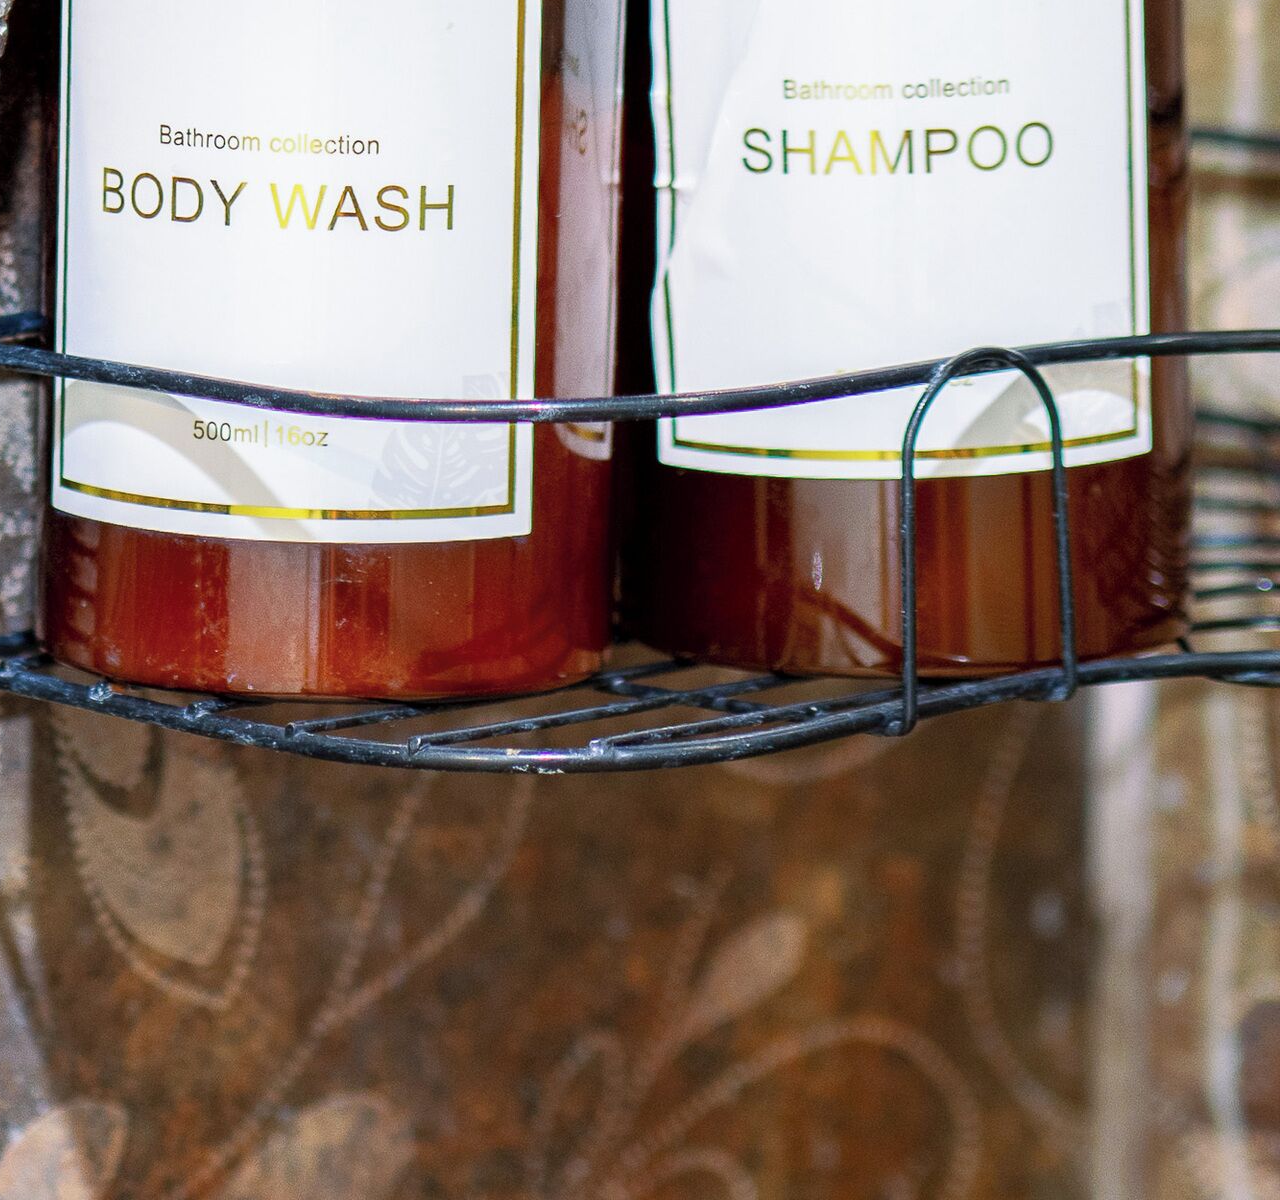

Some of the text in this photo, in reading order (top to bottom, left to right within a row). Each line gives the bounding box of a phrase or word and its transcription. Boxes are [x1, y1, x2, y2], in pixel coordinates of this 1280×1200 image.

[782, 76, 1011, 101] Bathroom collection
[159, 123, 380, 156] Bathroom collection
[741, 121, 1054, 176] SHAMPOO
[102, 166, 455, 232] BODY WASH
